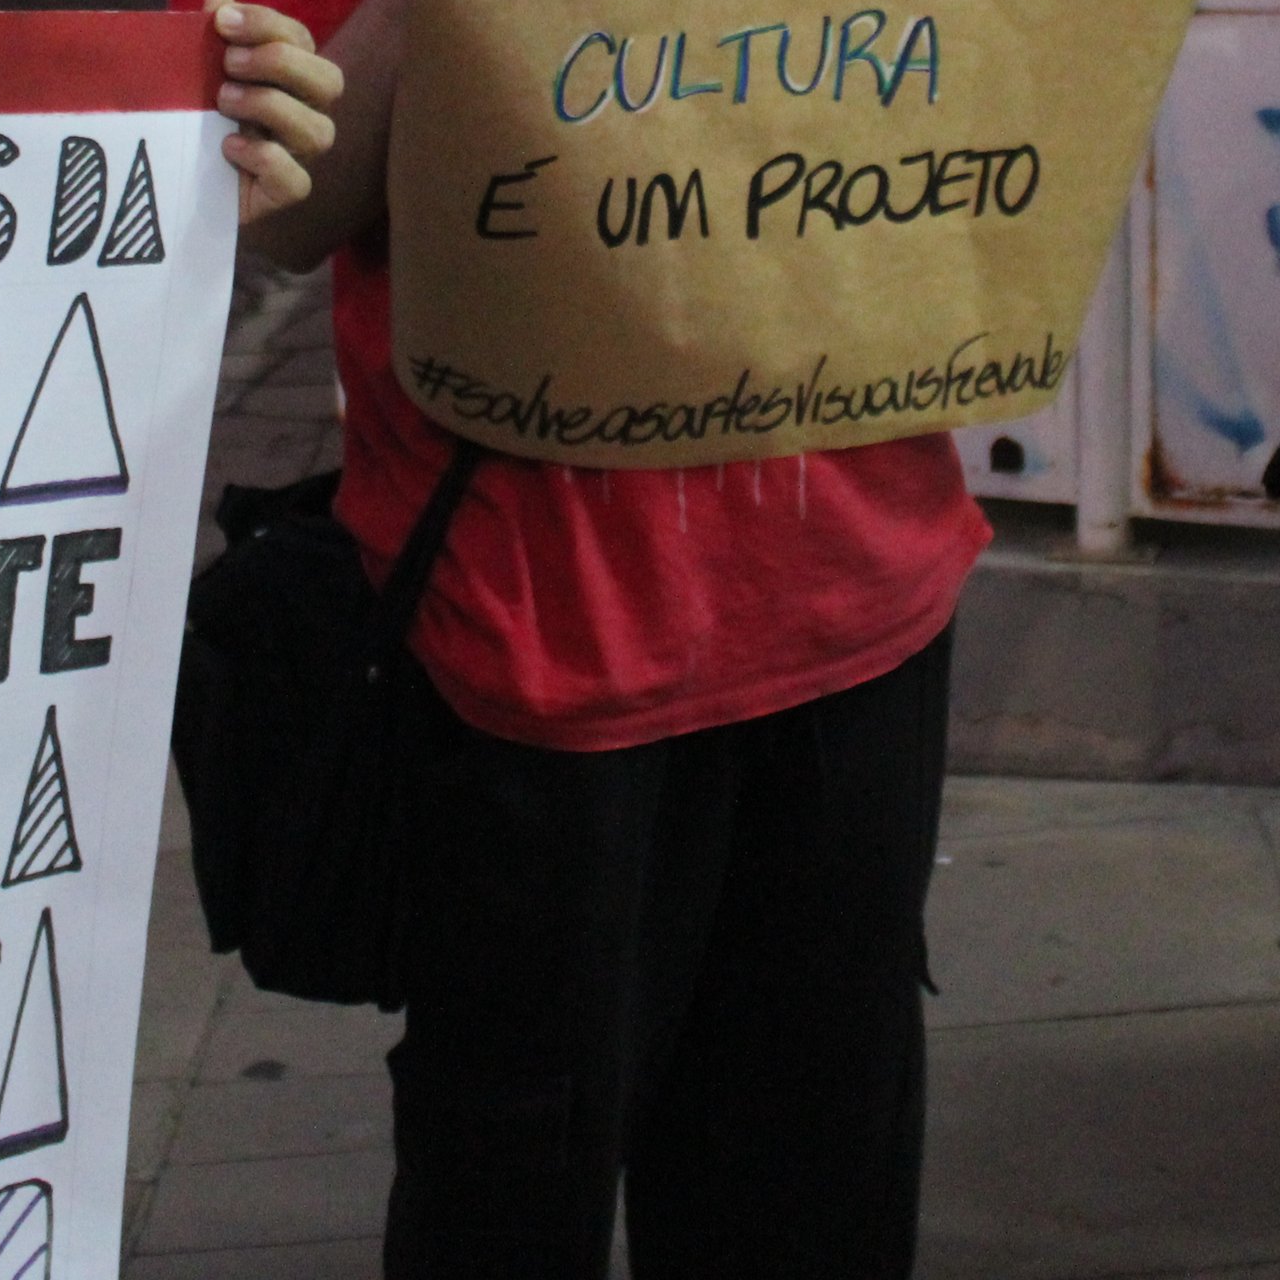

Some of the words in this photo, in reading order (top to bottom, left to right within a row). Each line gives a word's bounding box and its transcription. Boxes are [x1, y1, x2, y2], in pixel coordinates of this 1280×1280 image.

[553, 9, 941, 124] CULTURA
[47, 135, 165, 268] DA
[475, 155, 559, 240] É
[596, 167, 710, 248] UM
[745, 143, 1041, 240] PROJETO
